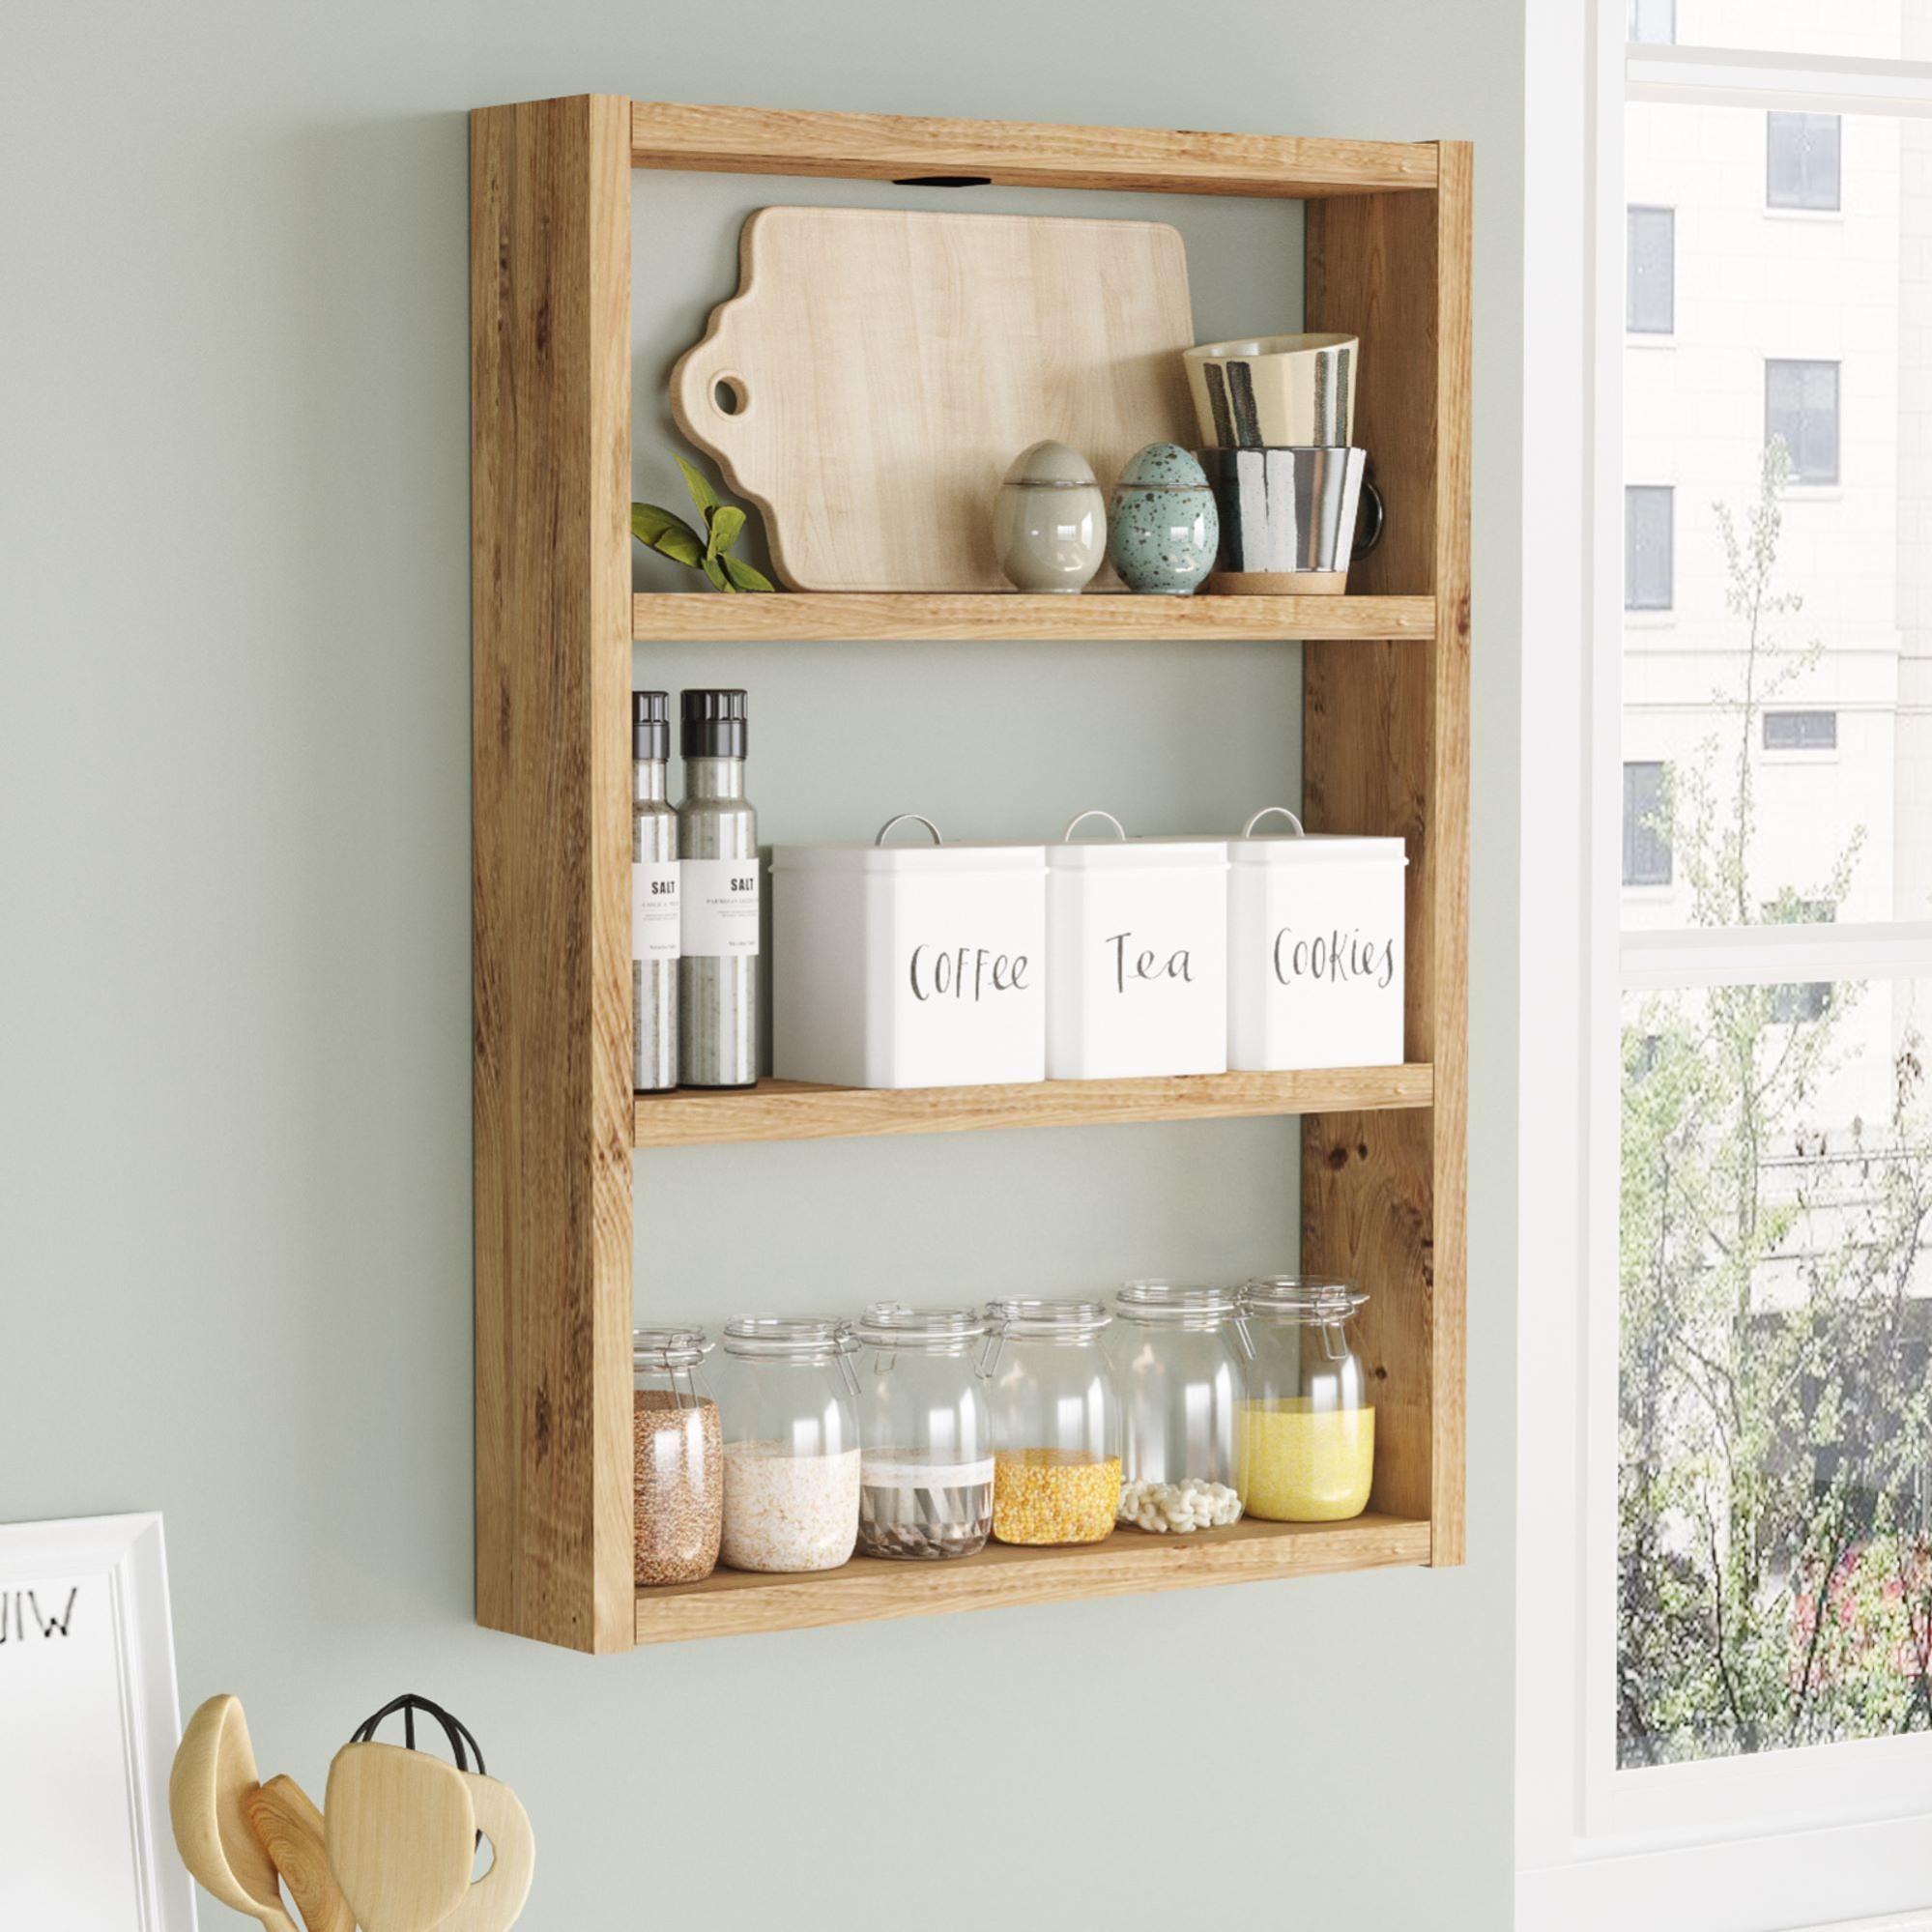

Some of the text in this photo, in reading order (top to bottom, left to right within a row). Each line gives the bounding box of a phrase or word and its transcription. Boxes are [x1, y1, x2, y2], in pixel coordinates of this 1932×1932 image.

[651, 880, 675, 895] SALT
[731, 878, 754, 892] SALT
[1106, 933, 1196, 994] Tea
